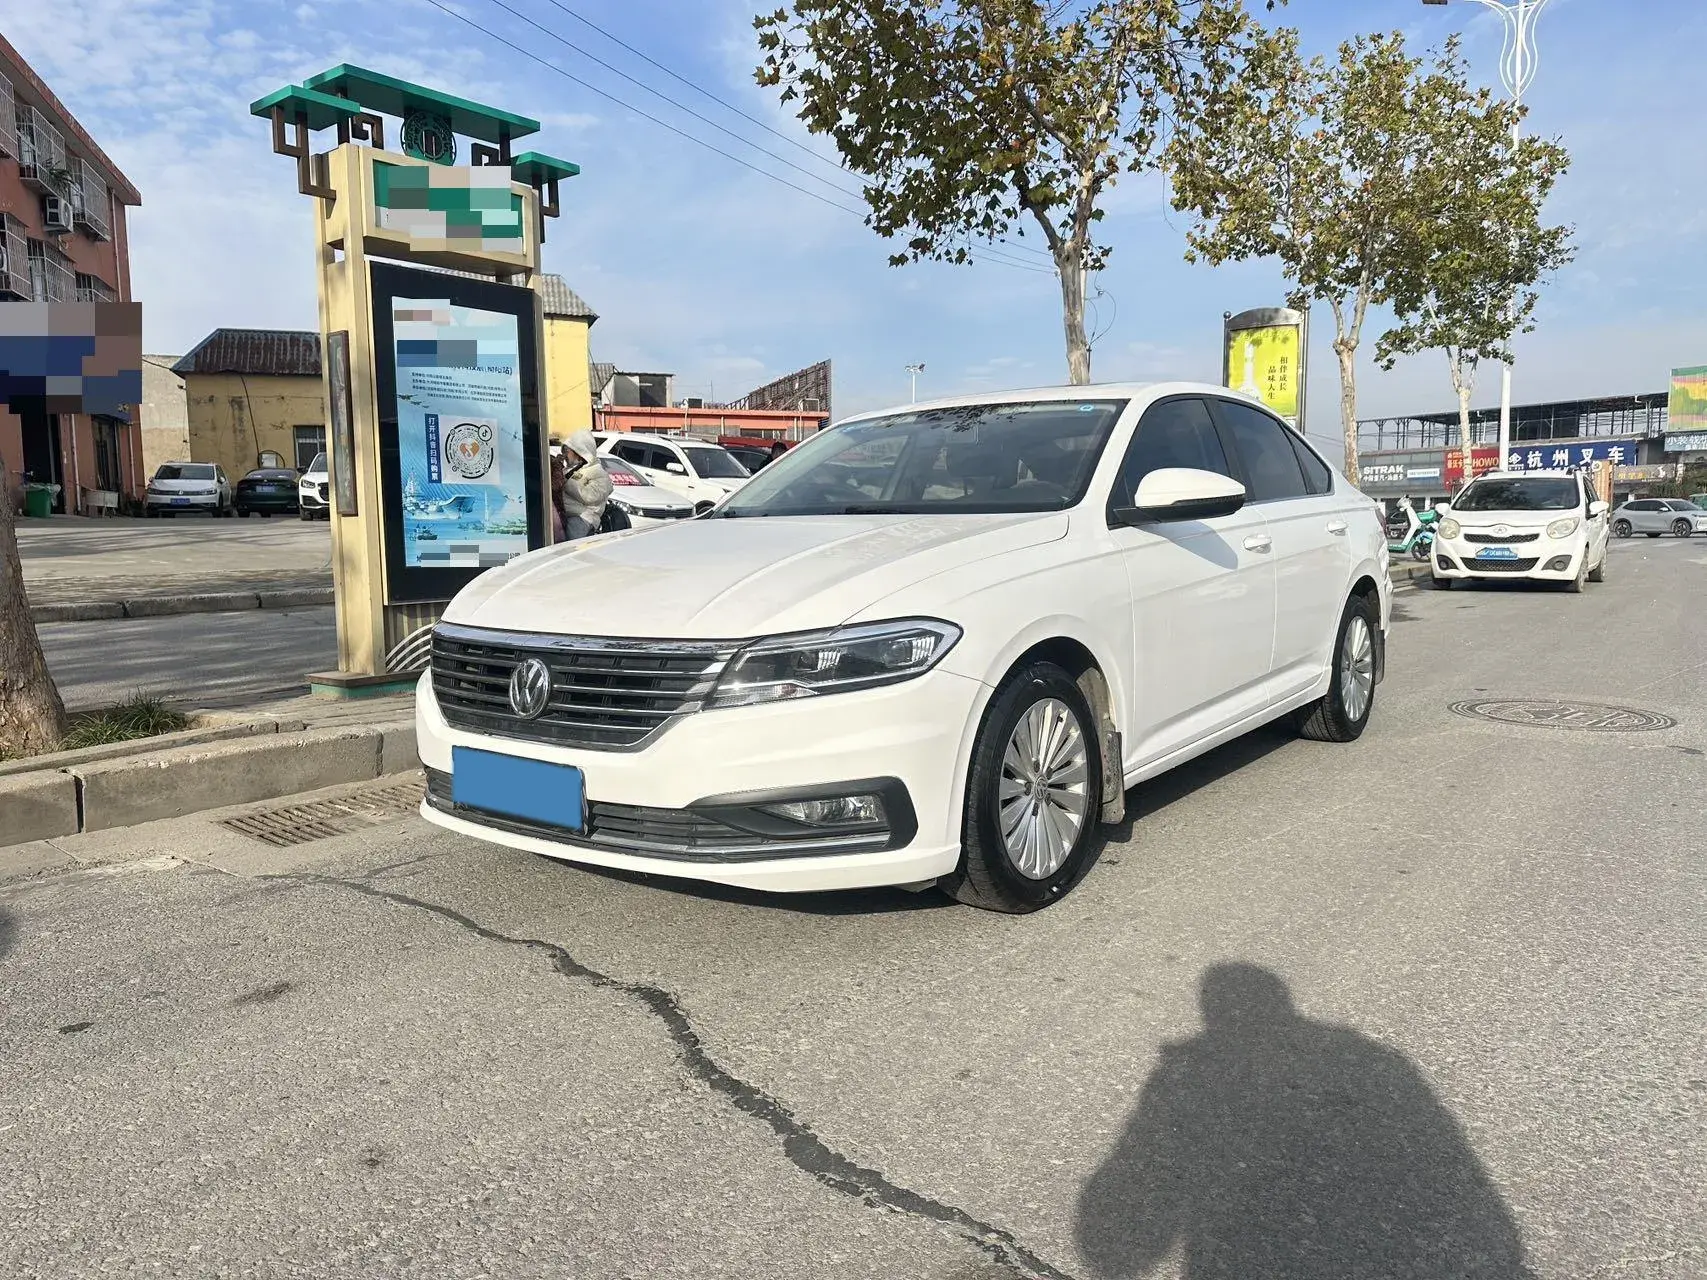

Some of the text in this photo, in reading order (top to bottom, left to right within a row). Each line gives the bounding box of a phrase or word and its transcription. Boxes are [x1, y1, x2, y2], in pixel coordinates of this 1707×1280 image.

[1267, 366, 1276, 400] 品味人生
[1279, 356, 1288, 391] 相伴成长
[428, 417, 439, 480] 打开抖音扫码购票
[1472, 457, 1499, 467] HOWO
[1527, 446, 1625, 467] 杭州叉车
[1363, 465, 1404, 474] SITRAK
